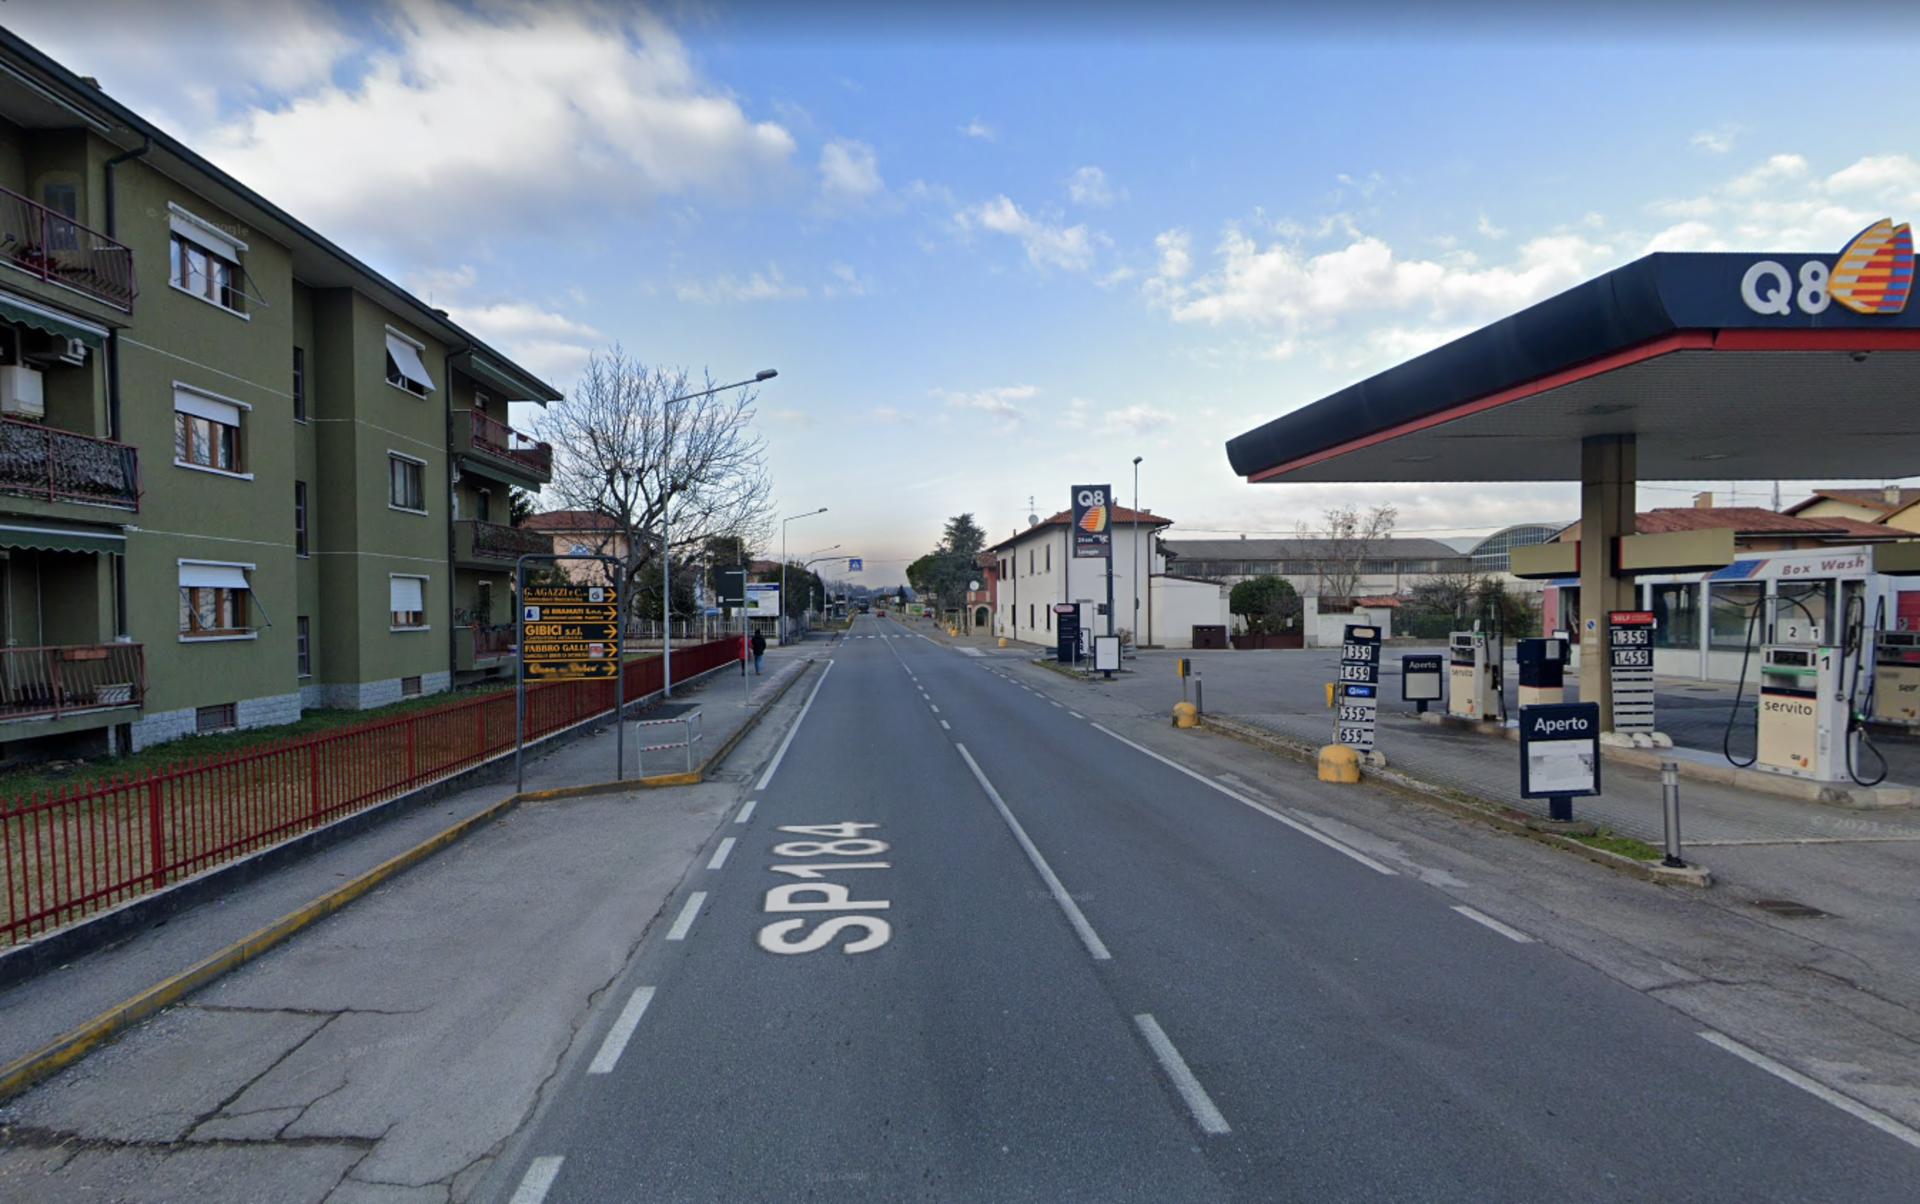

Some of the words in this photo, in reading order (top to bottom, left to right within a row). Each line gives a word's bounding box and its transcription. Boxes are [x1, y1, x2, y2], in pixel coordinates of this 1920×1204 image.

[1741, 260, 1832, 315] Q8
[1078, 490, 1105, 507] Q8
[1782, 565, 1812, 576] Box
[1821, 556, 1865, 571] Wash
[525, 625, 562, 636] GIBICI
[1789, 627, 1797, 638] 2
[1812, 628, 1819, 639] 1
[524, 644, 560, 653] FABBRO
[562, 643, 589, 652] GALLI
[1409, 661, 1438, 670] Aperto
[1821, 656, 1830, 671] 1
[1764, 701, 1813, 716] servito
[1534, 717, 1589, 735] Aperto
[758, 821, 892, 955] SP184
